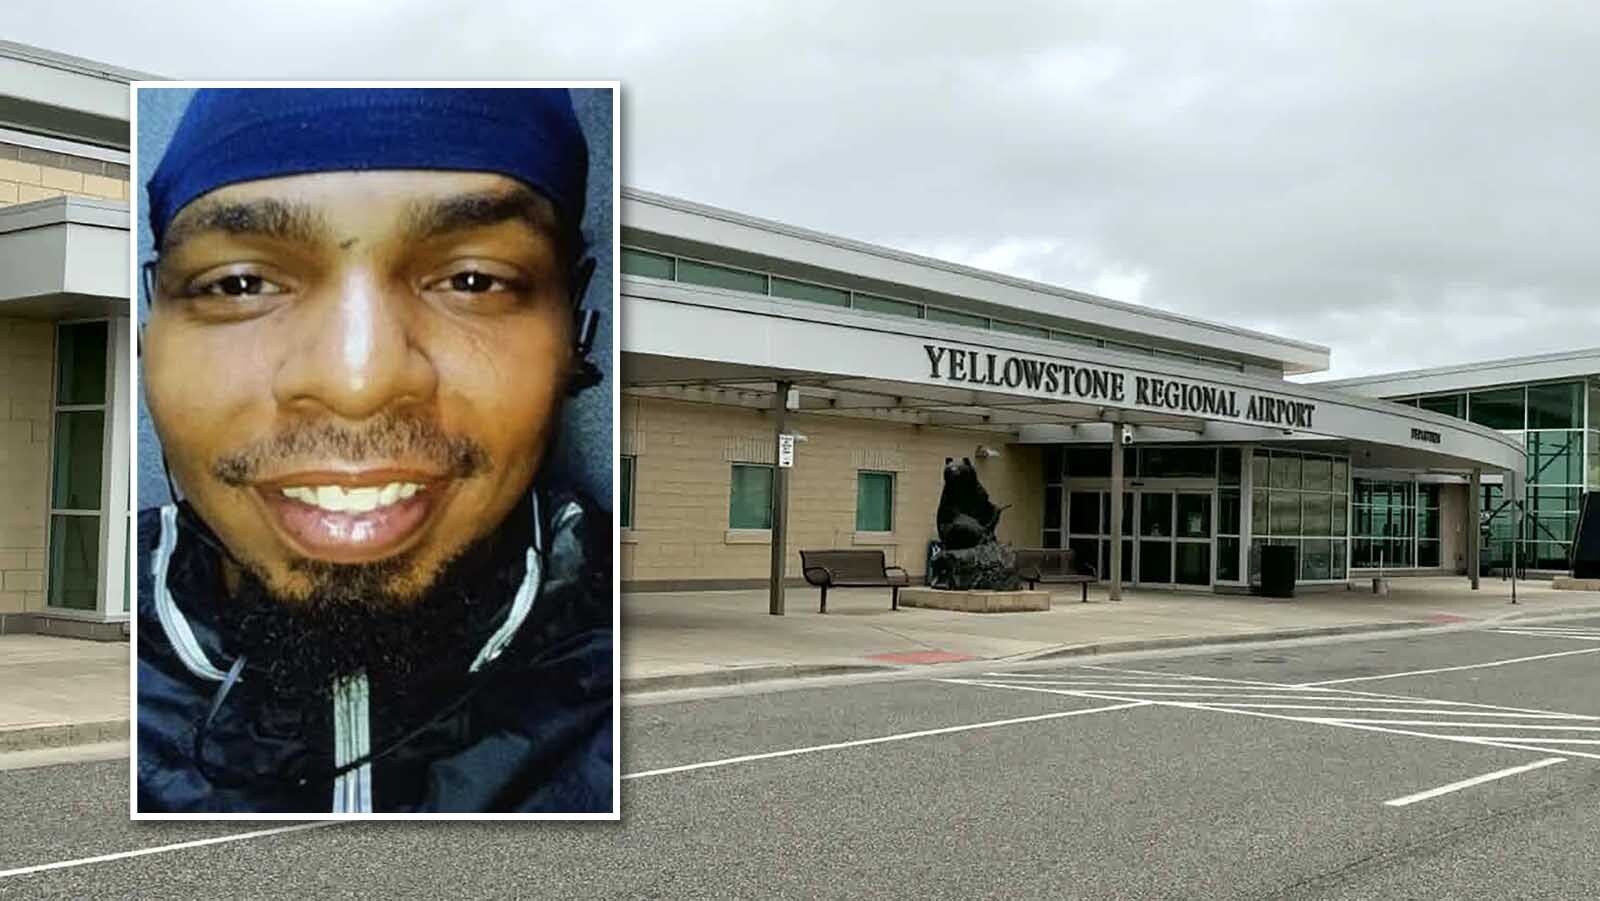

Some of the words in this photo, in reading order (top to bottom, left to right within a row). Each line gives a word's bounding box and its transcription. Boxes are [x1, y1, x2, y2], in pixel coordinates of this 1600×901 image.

[924, 344, 1125, 401] YELLOWSTONE
[1136, 376, 1240, 417] REGIONAL
[1246, 395, 1316, 428] AIRPORT
